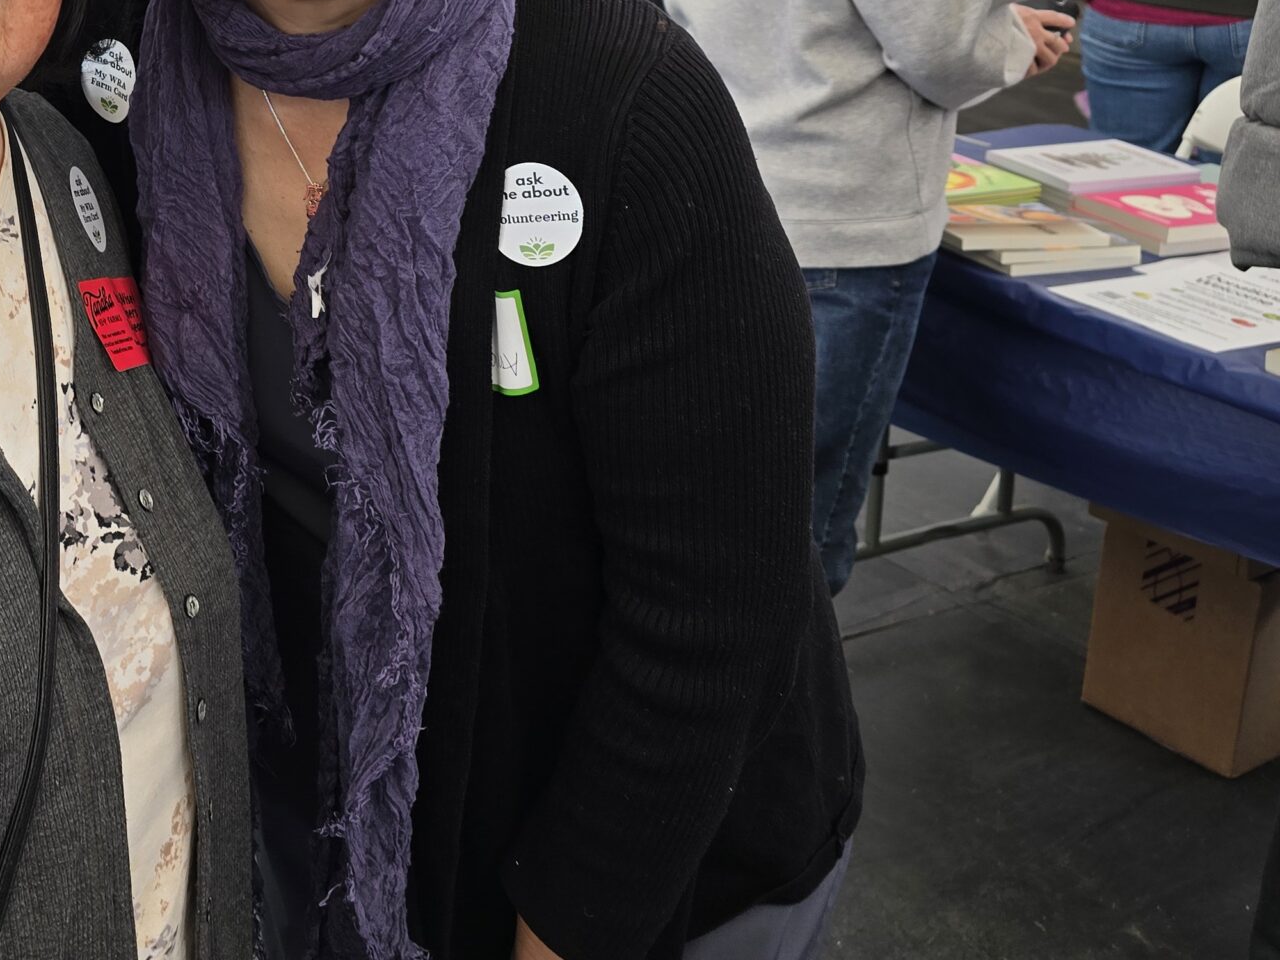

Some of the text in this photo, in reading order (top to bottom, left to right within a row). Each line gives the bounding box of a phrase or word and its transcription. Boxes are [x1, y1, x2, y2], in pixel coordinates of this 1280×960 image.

[109, 51, 123, 62] ask
[110, 60, 132, 78] about
[94, 68, 127, 90] My WRA
[90, 77, 128, 102] Farm Card
[515, 171, 544, 186] ask
[522, 185, 570, 199] about
[500, 210, 579, 225] olunteering
[82, 286, 115, 329] Tanaka
